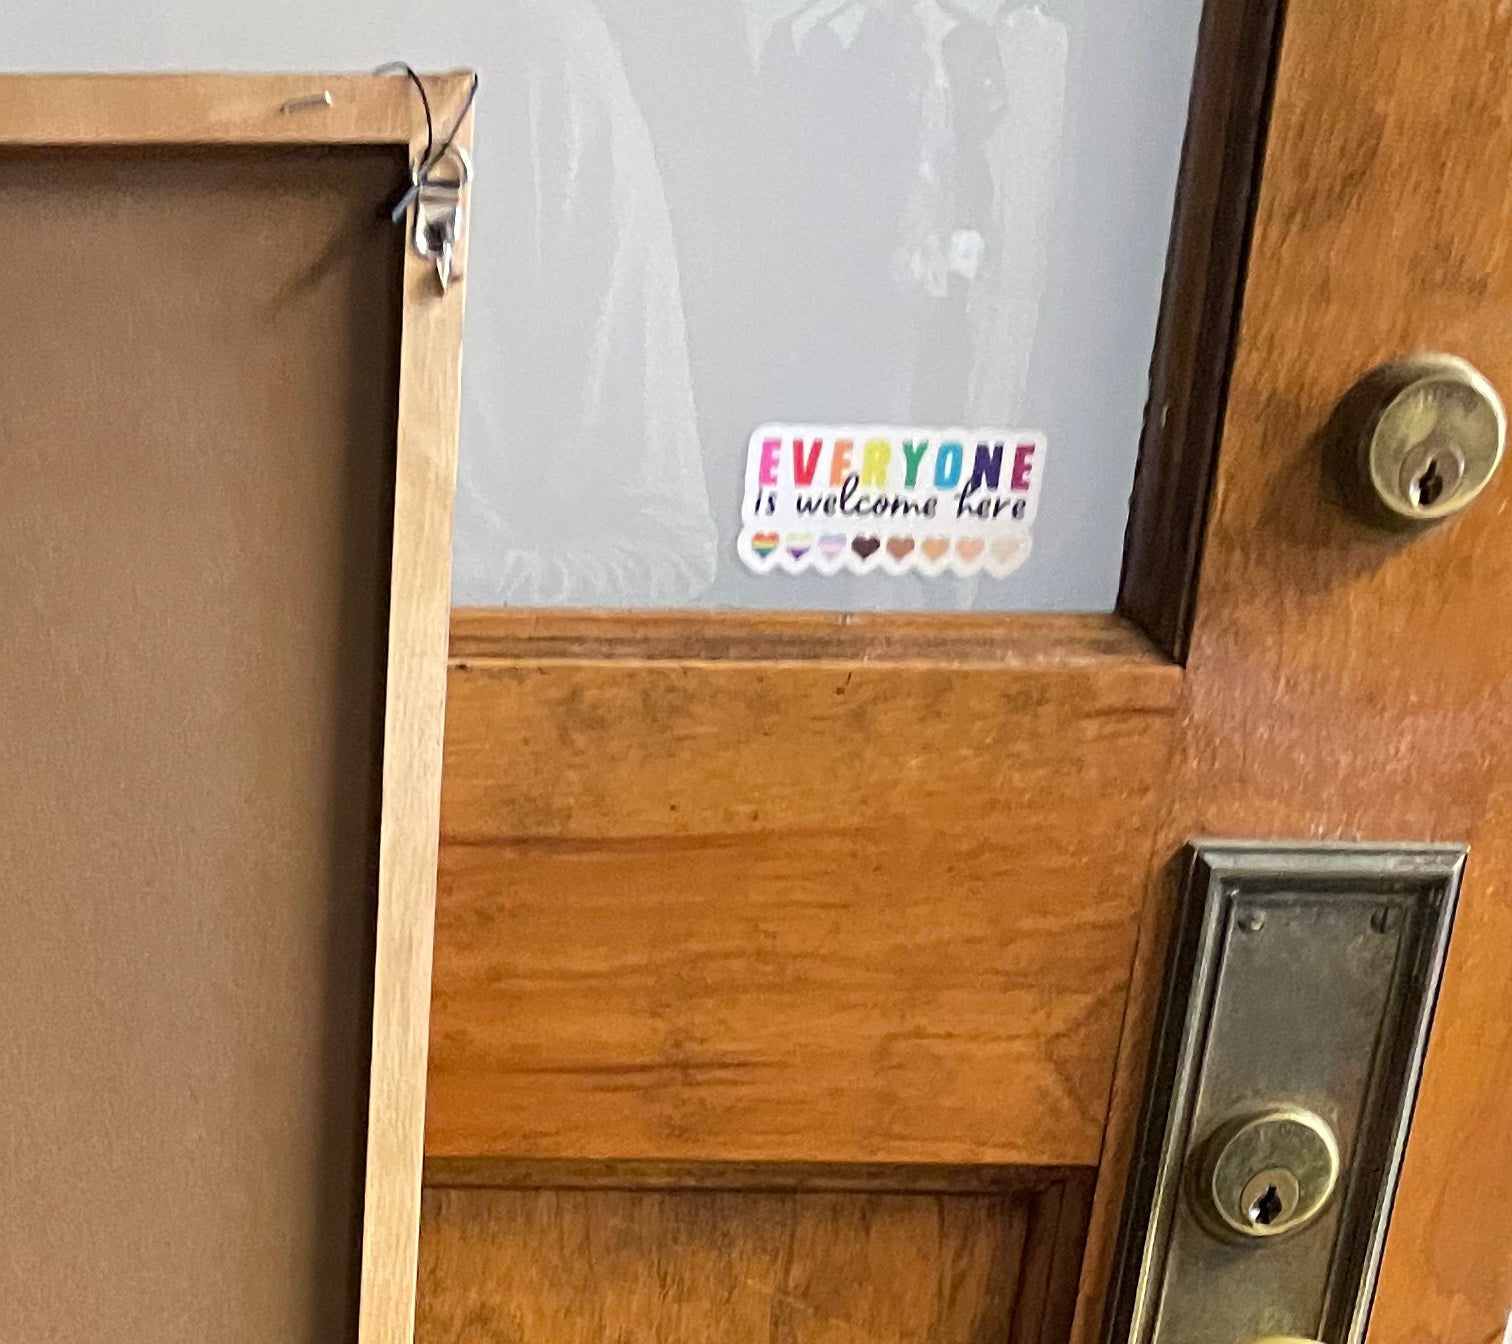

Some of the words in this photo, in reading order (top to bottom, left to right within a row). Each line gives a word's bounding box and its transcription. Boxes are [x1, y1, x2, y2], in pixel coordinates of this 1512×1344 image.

[758, 436, 1036, 493] EVERYONE
[754, 484, 777, 517] is
[796, 472, 938, 519] welcome
[954, 480, 1028, 521] here
